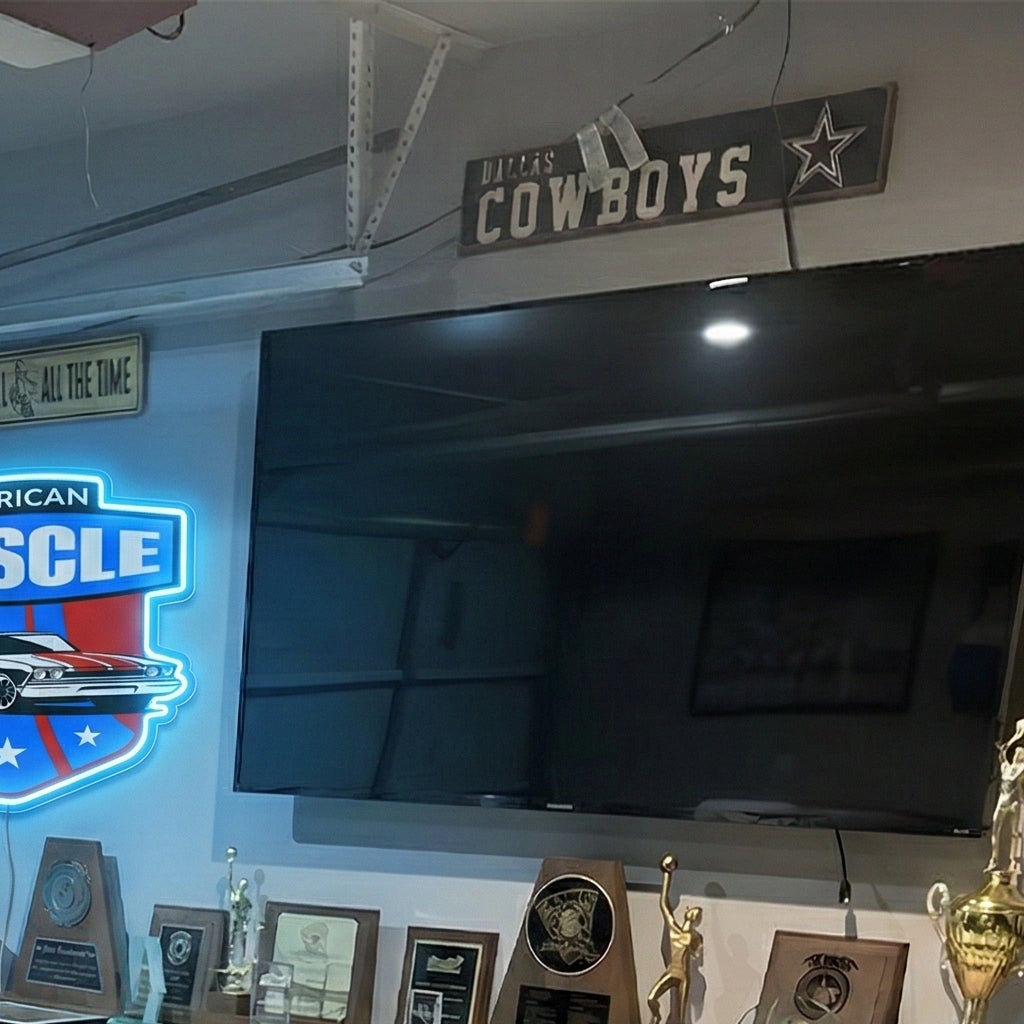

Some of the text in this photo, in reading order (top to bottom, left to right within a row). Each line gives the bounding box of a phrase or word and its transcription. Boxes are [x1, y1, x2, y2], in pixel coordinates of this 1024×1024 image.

[476, 145, 751, 245] COWBOYS
[41, 364, 63, 403] ALL
[67, 361, 93, 400] THE
[97, 356, 131, 397] TIME
